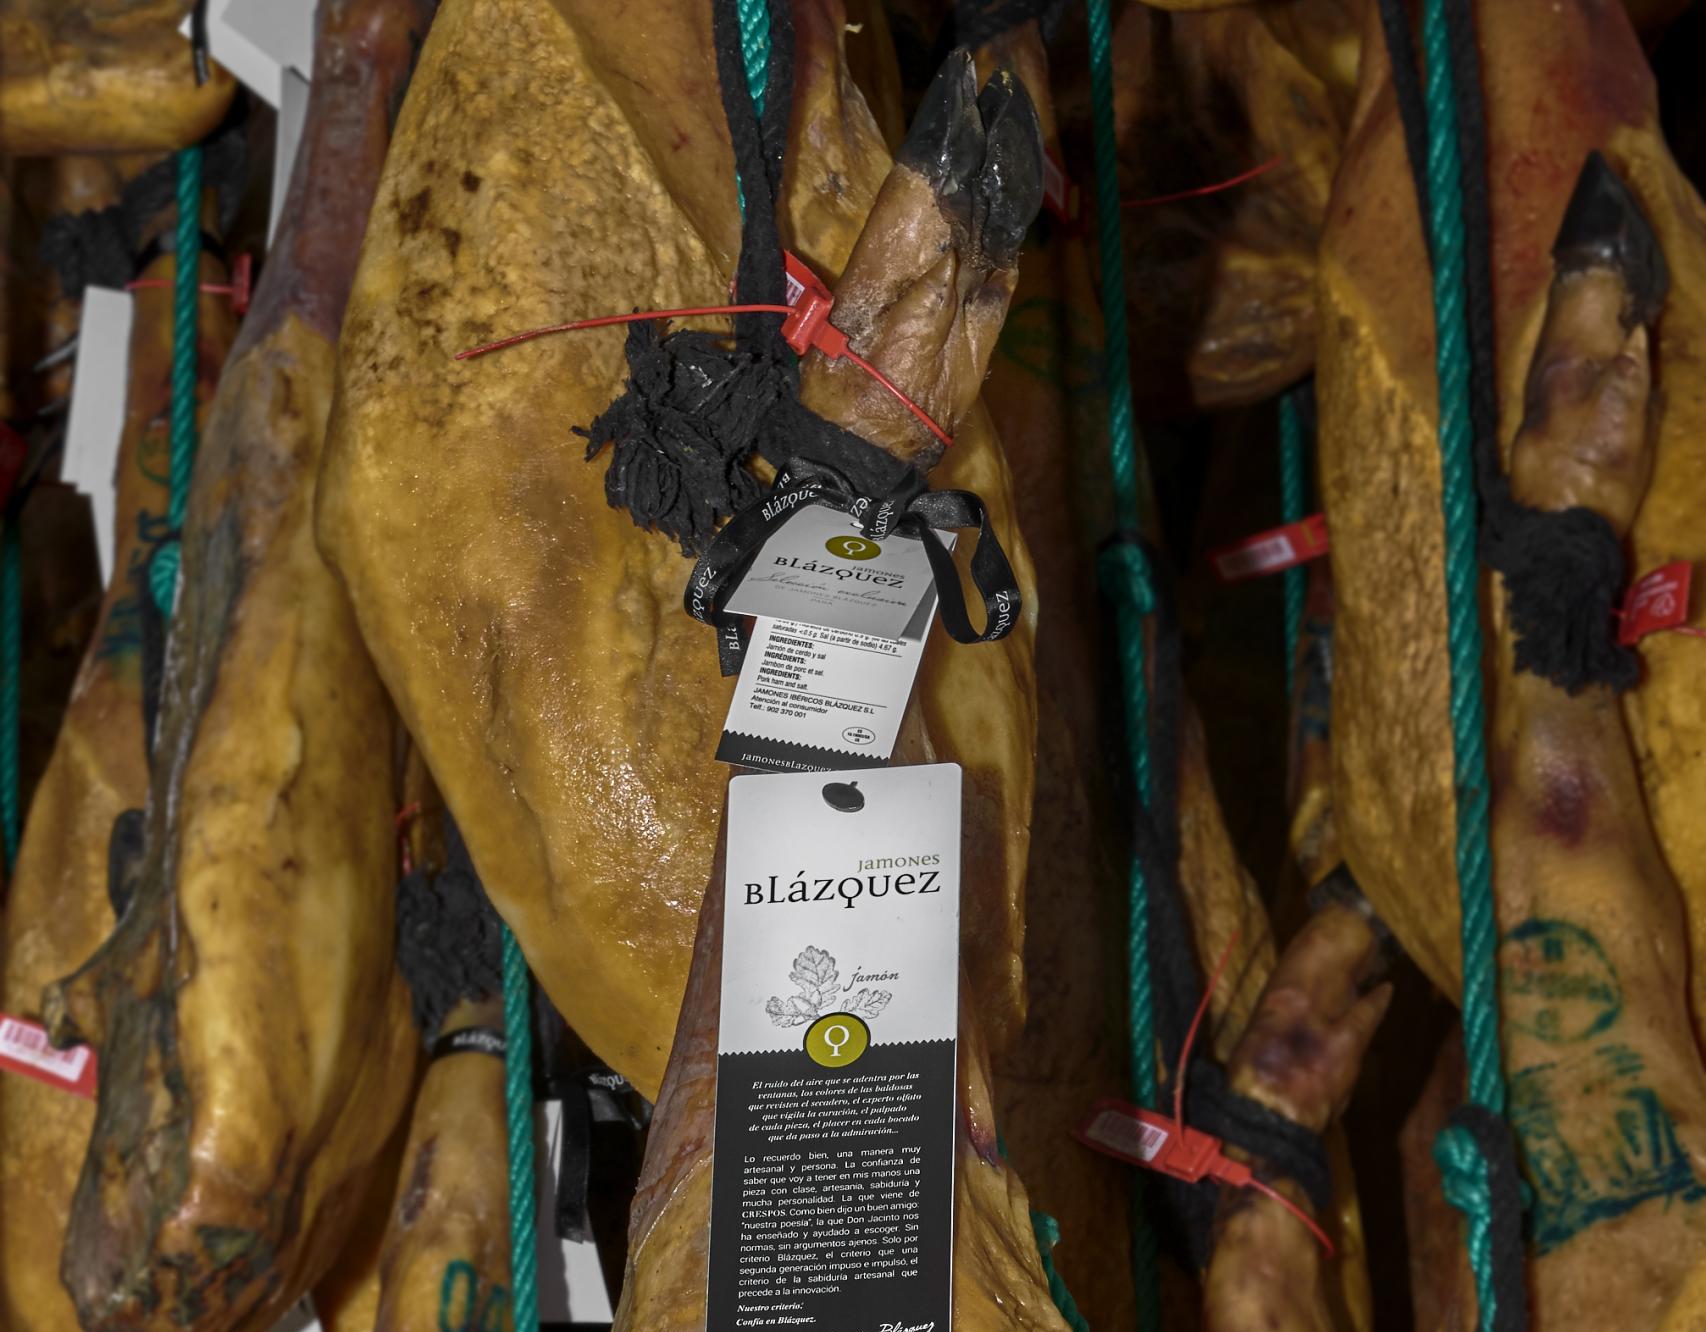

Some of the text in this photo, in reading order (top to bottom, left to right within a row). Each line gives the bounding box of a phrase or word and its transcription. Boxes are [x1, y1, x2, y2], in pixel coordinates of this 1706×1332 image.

[752, 1081, 763, 1089] El
[764, 1080, 789, 1089] ruido
[790, 1079, 804, 1087] del
[805, 1078, 824, 1086] aire
[824, 1078, 841, 1087] que
[852, 1075, 887, 1083] adentra
[888, 1074, 906, 1083] por
[906, 1072, 920, 1080] las
[748, 1124, 760, 1132] de
[761, 1122, 783, 1131] cada
[812, 1120, 821, 1128] el
[821, 1119, 851, 1129] placer
[864, 1116, 886, 1125] cada
[887, 1114, 920, 1123] bocado
[768, 1135, 784, 1143] que
[785, 1132, 798, 1140] da
[798, 1133, 820, 1141] paso
[830, 1130, 840, 1138] la
[744, 1155, 756, 1163] Lo
[763, 1153, 802, 1162] recuerdo
[860, 1148, 894, 1156] manera
[902, 1146, 921, 1154] muy
[744, 1164, 784, 1174] artesanal
[790, 1165, 796, 1174] y
[844, 1161, 856, 1169] La
[861, 1158, 904, 1168] confianza
[909, 1156, 921, 1164] de
[743, 1177, 768, 1185] saber
[770, 1177, 787, 1185] que
[788, 1176, 804, 1184] voy
[814, 1174, 837, 1182] tener
[852, 1171, 869, 1179] mis
[871, 1169, 902, 1178] manos
[904, 1168, 920, 1176] una
[742, 1188, 766, 1198] pieza
[870, 1179, 910, 1189] sabiduría
[914, 1179, 920, 1188] y
[742, 1198, 773, 1207] mucha
[842, 1194, 852, 1202] La
[858, 1194, 875, 1202] que
[908, 1189, 920, 1198] de
[789, 1208, 816, 1216] Como
[816, 1206, 836, 1215] bien
[836, 1205, 853, 1215] dijo
[866, 1203, 889, 1212] buen
[816, 1218, 824, 1226] la
[827, 1218, 844, 1226] que
[847, 1216, 865, 1224] Don
[868, 1214, 900, 1223] Jacinto
[740, 1233, 752, 1241] ha
[756, 1230, 799, 1240] enseñado
[802, 1231, 809, 1240] y
[812, 1227, 850, 1239] ayudado
[904, 1223, 919, 1232] Sin
[793, 1240, 846, 1251] argumentos
[882, 1235, 902, 1244] Solo
[904, 1235, 918, 1244] por
[739, 1255, 770, 1264] criterio
[825, 1251, 834, 1259] el
[840, 1249, 871, 1258] criterio
[878, 1248, 895, 1257] que
[739, 1265, 777, 1276] segunda
[778, 1263, 827, 1275] generación
[829, 1262, 862, 1271] impuso
[910, 1256, 918, 1265] el
[738, 1269, 918, 1286] criterio de la sabiduría artesanal que
[736, 1317, 764, 1327] Confía
